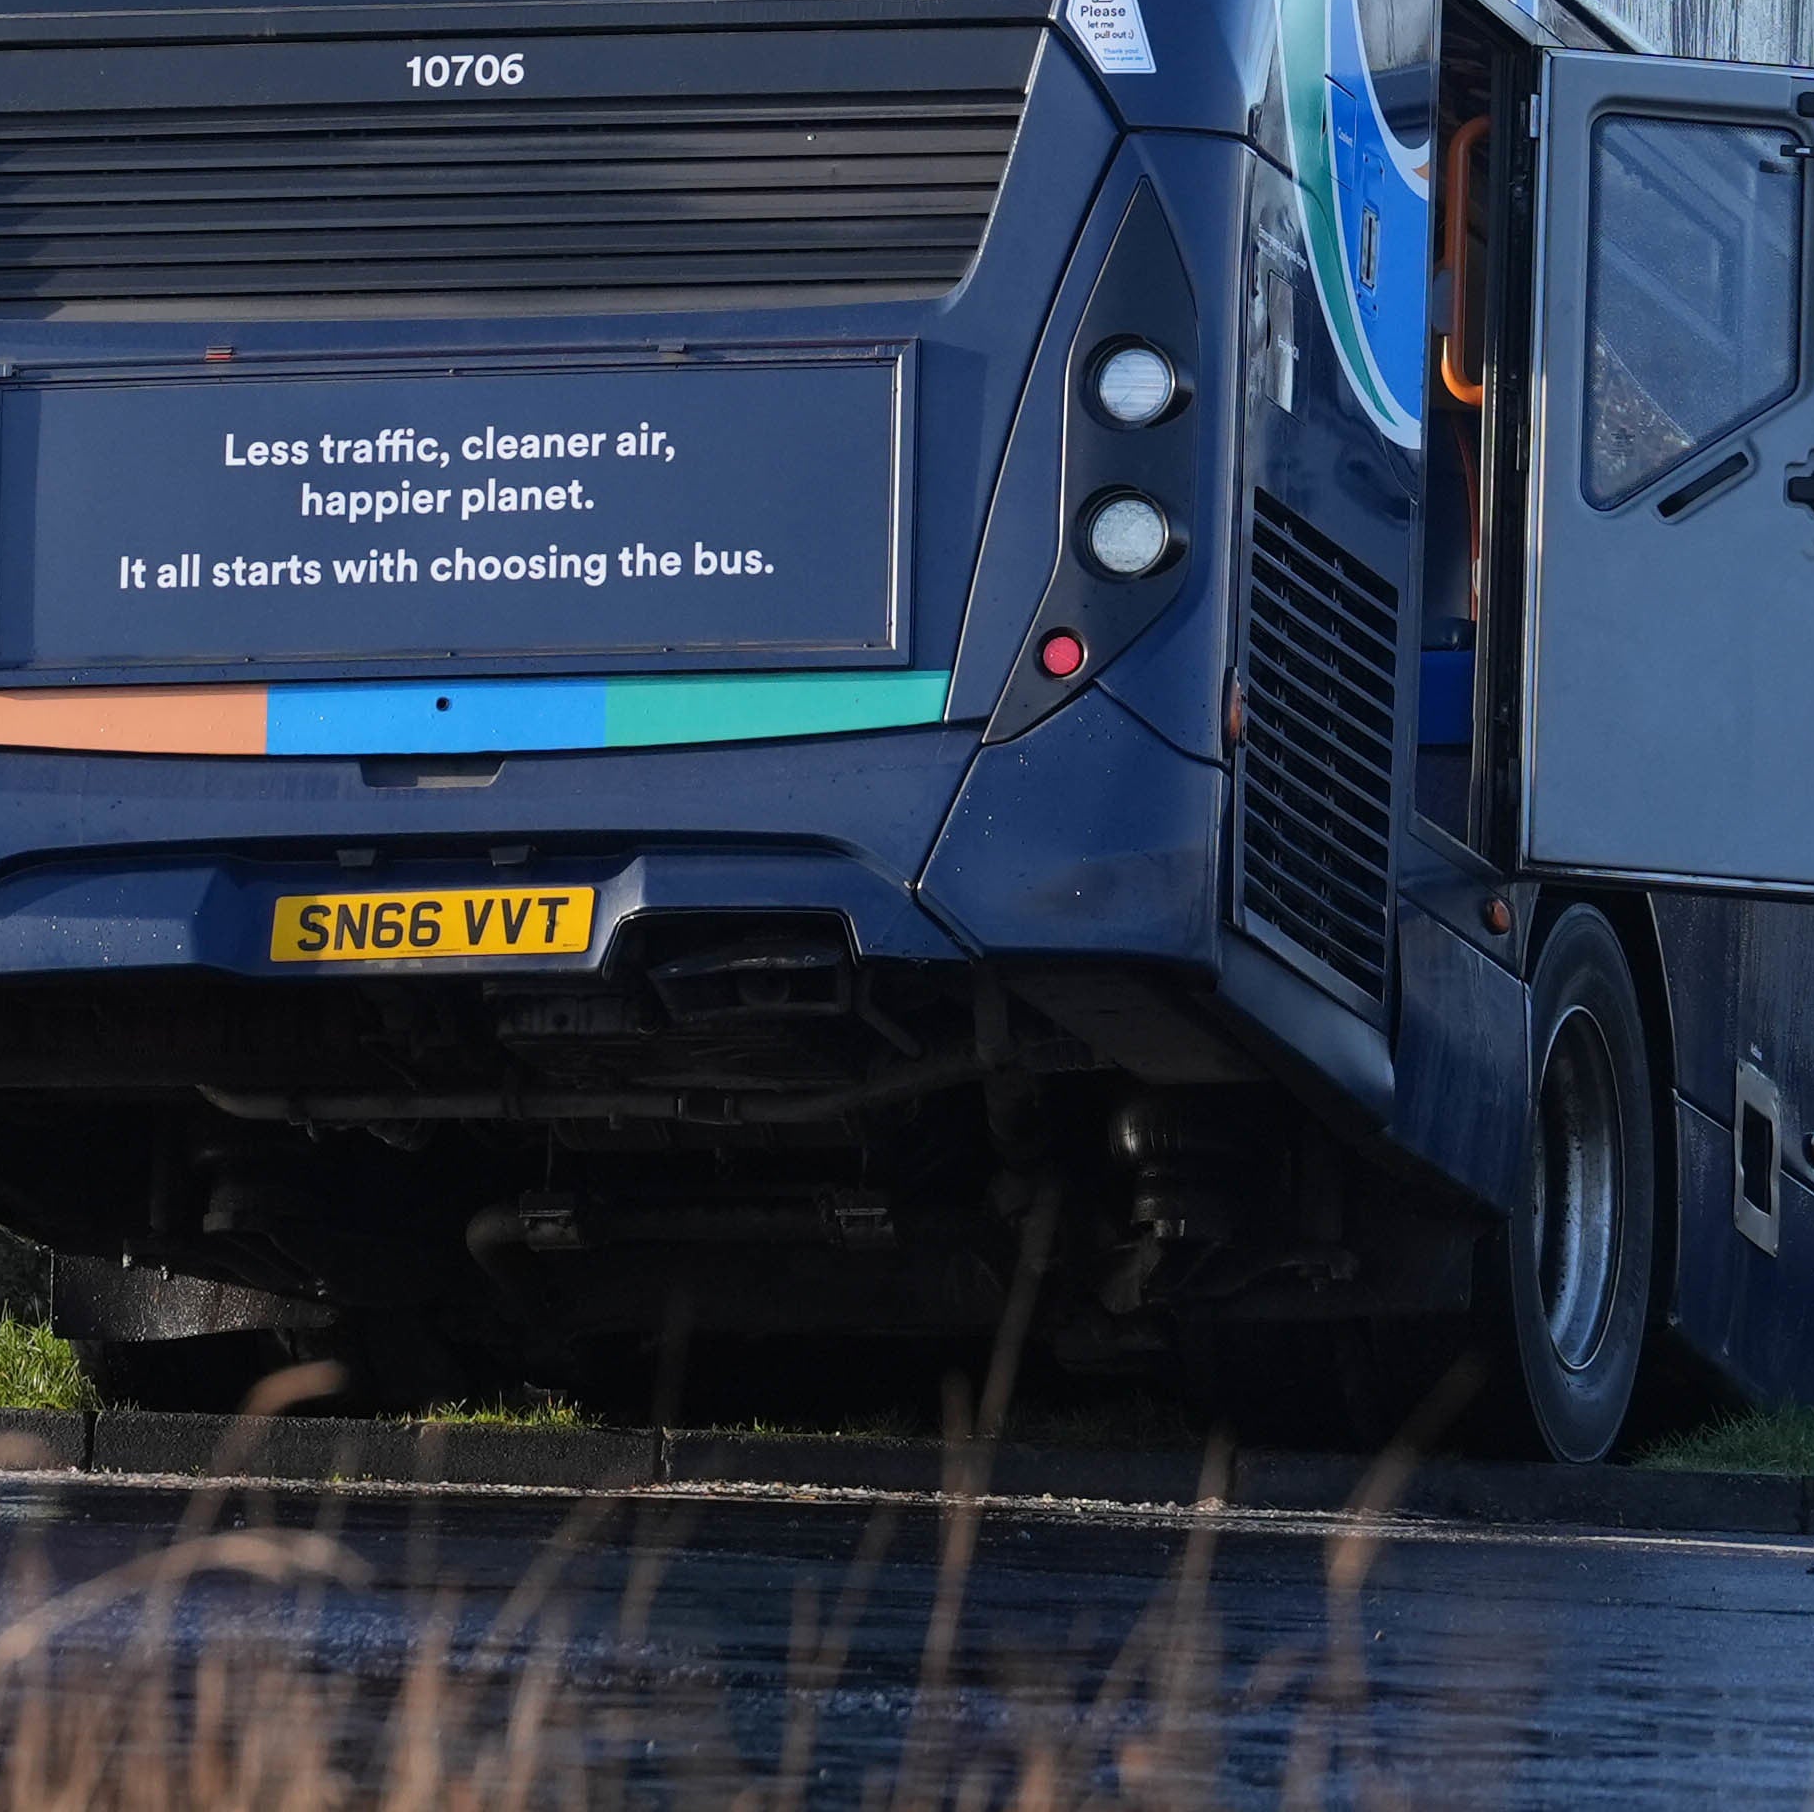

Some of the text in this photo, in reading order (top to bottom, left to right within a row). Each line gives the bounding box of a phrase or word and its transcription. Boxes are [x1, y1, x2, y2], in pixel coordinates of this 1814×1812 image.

[1080, 5, 1126, 17] Please
[1088, 20, 1098, 28] let
[1094, 30, 1110, 41] pull
[406, 53, 525, 87] 10706
[225, 422, 676, 468] Less traffic, cleaner air,
[302, 479, 594, 522] happier planet.
[120, 542, 775, 589] It all starts with choosing the bus.
[297, 896, 569, 952] SN66 VVT
